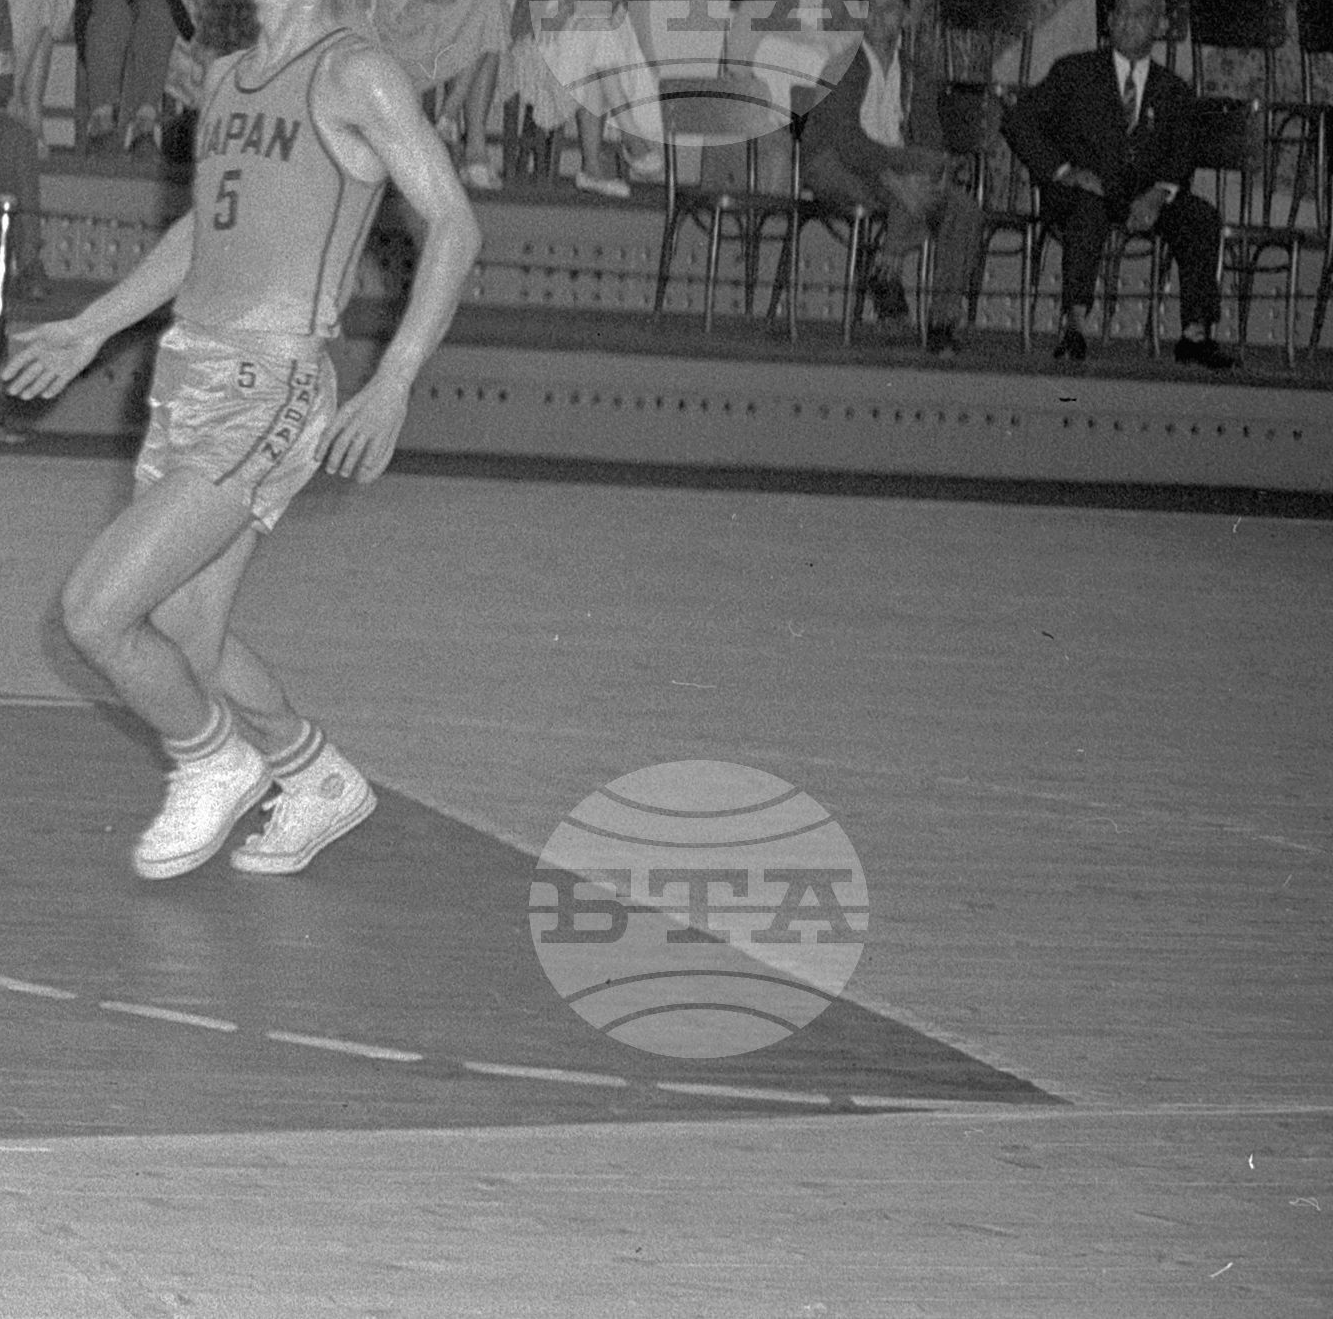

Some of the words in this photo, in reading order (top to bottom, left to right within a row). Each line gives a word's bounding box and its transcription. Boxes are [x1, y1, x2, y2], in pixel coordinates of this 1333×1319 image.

[196, 112, 302, 162] JAPAN
[213, 168, 243, 231] 5
[237, 361, 257, 389] 5
[261, 372, 315, 461] JAPAN
